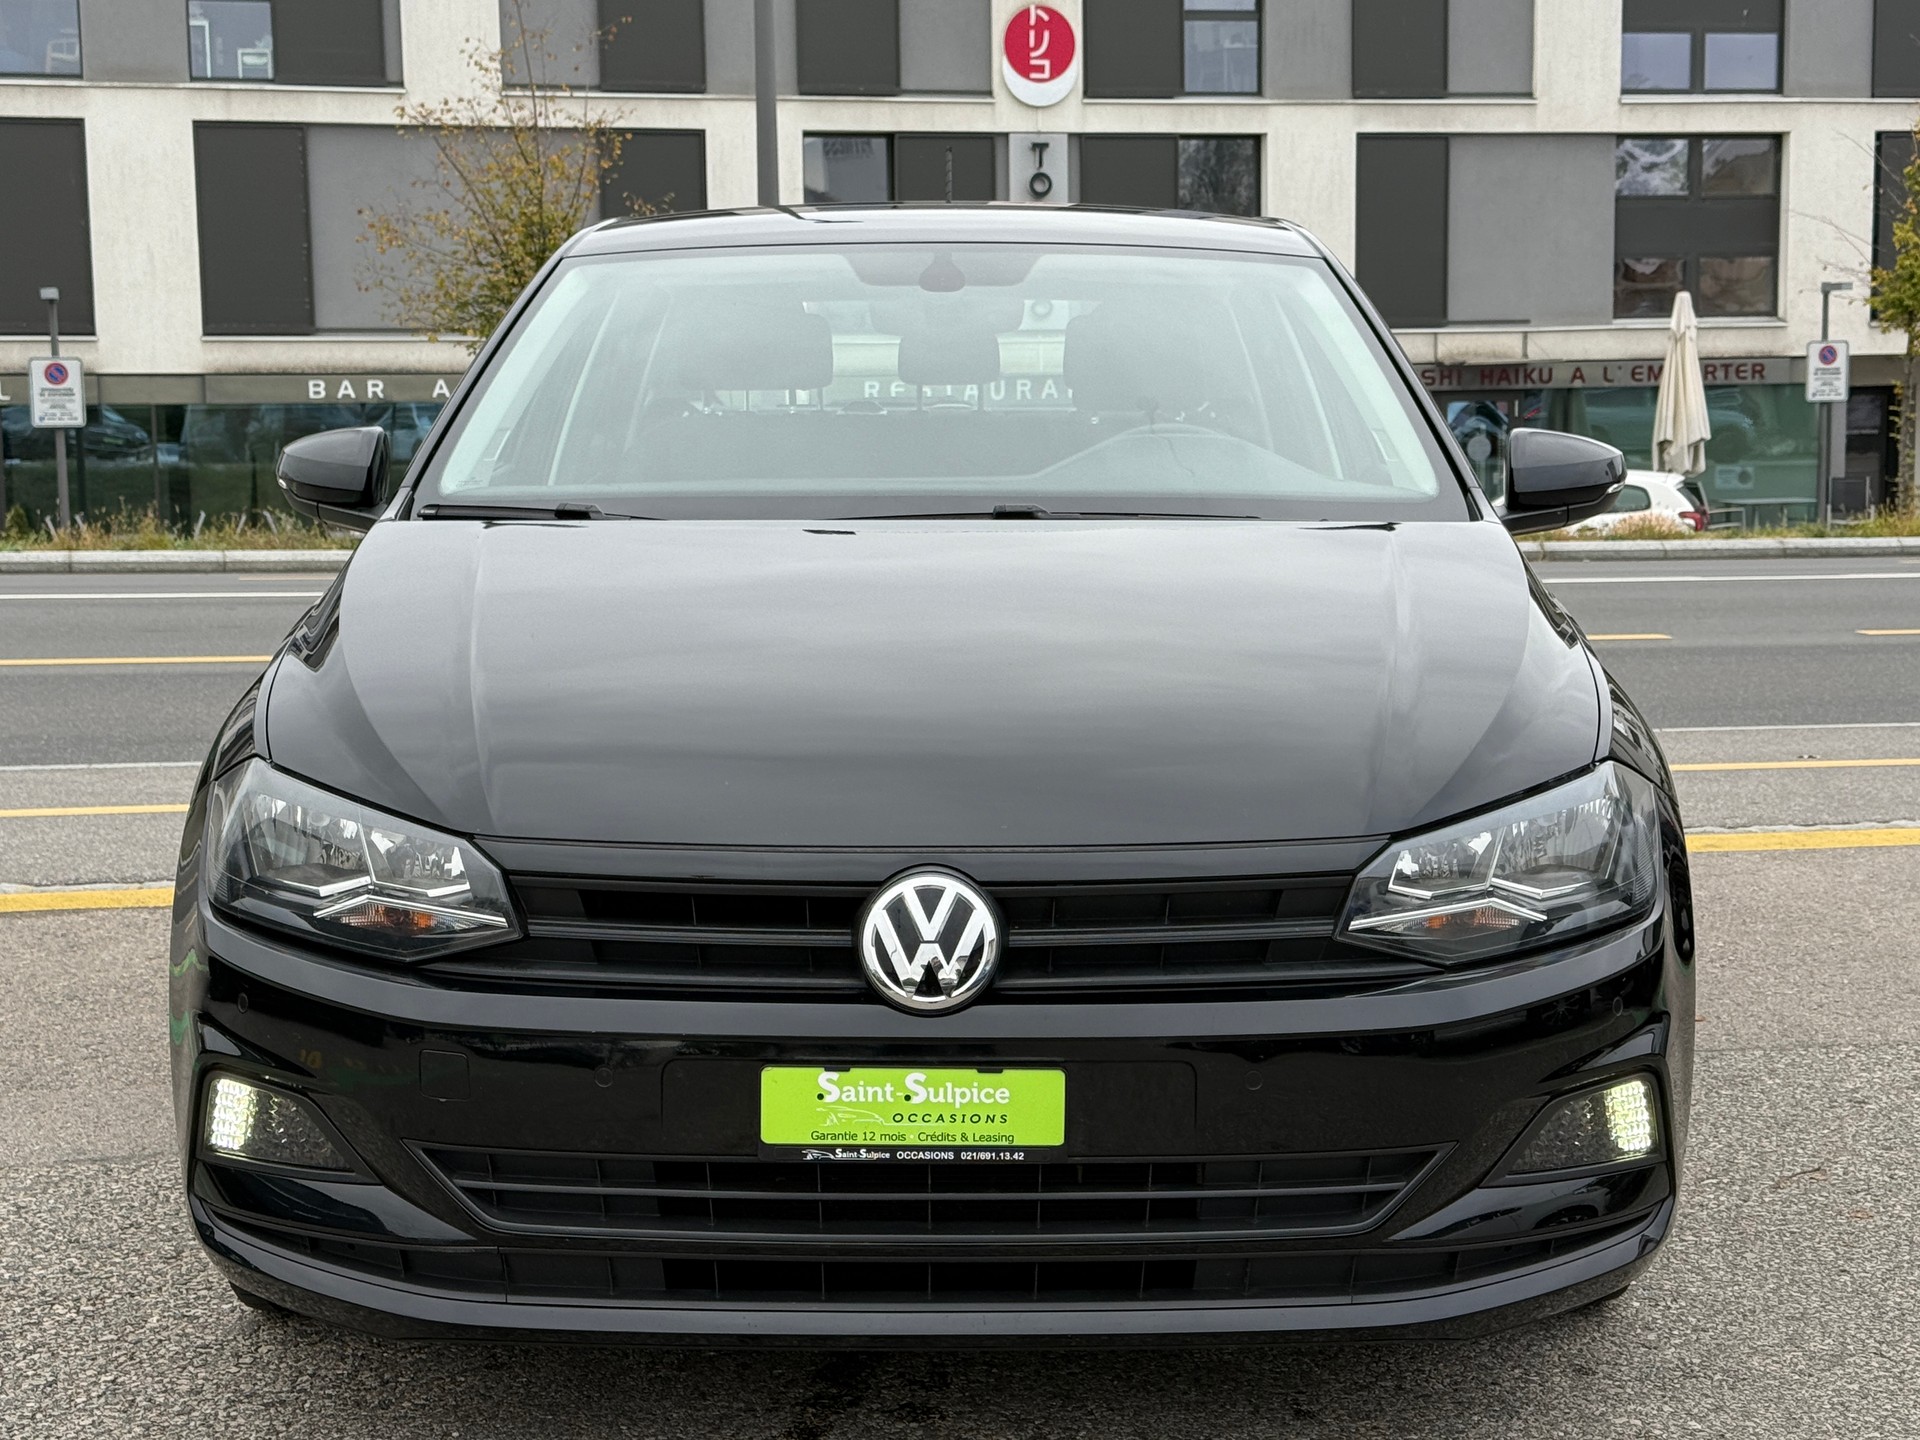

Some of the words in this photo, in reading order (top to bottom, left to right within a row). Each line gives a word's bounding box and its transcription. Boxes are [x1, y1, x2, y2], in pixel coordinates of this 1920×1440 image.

[1480, 366, 1552, 386] HAIKU
[1570, 366, 1586, 384] A
[1602, 362, 1766, 384] L'EMRTER
[307, 379, 385, 400] BAR
[892, 1113, 1009, 1124] OCCASIONS
[810, 1131, 858, 1142] Garantie
[862, 1131, 876, 1142] 12
[880, 1131, 907, 1142] mois
[918, 1131, 957, 1143] Crédits
[960, 1132, 969, 1142] &
[972, 1132, 1015, 1145] Leasing
[896, 1151, 955, 1160] OCCASIONS
[960, 1151, 1025, 1161] 021/691.13.42
